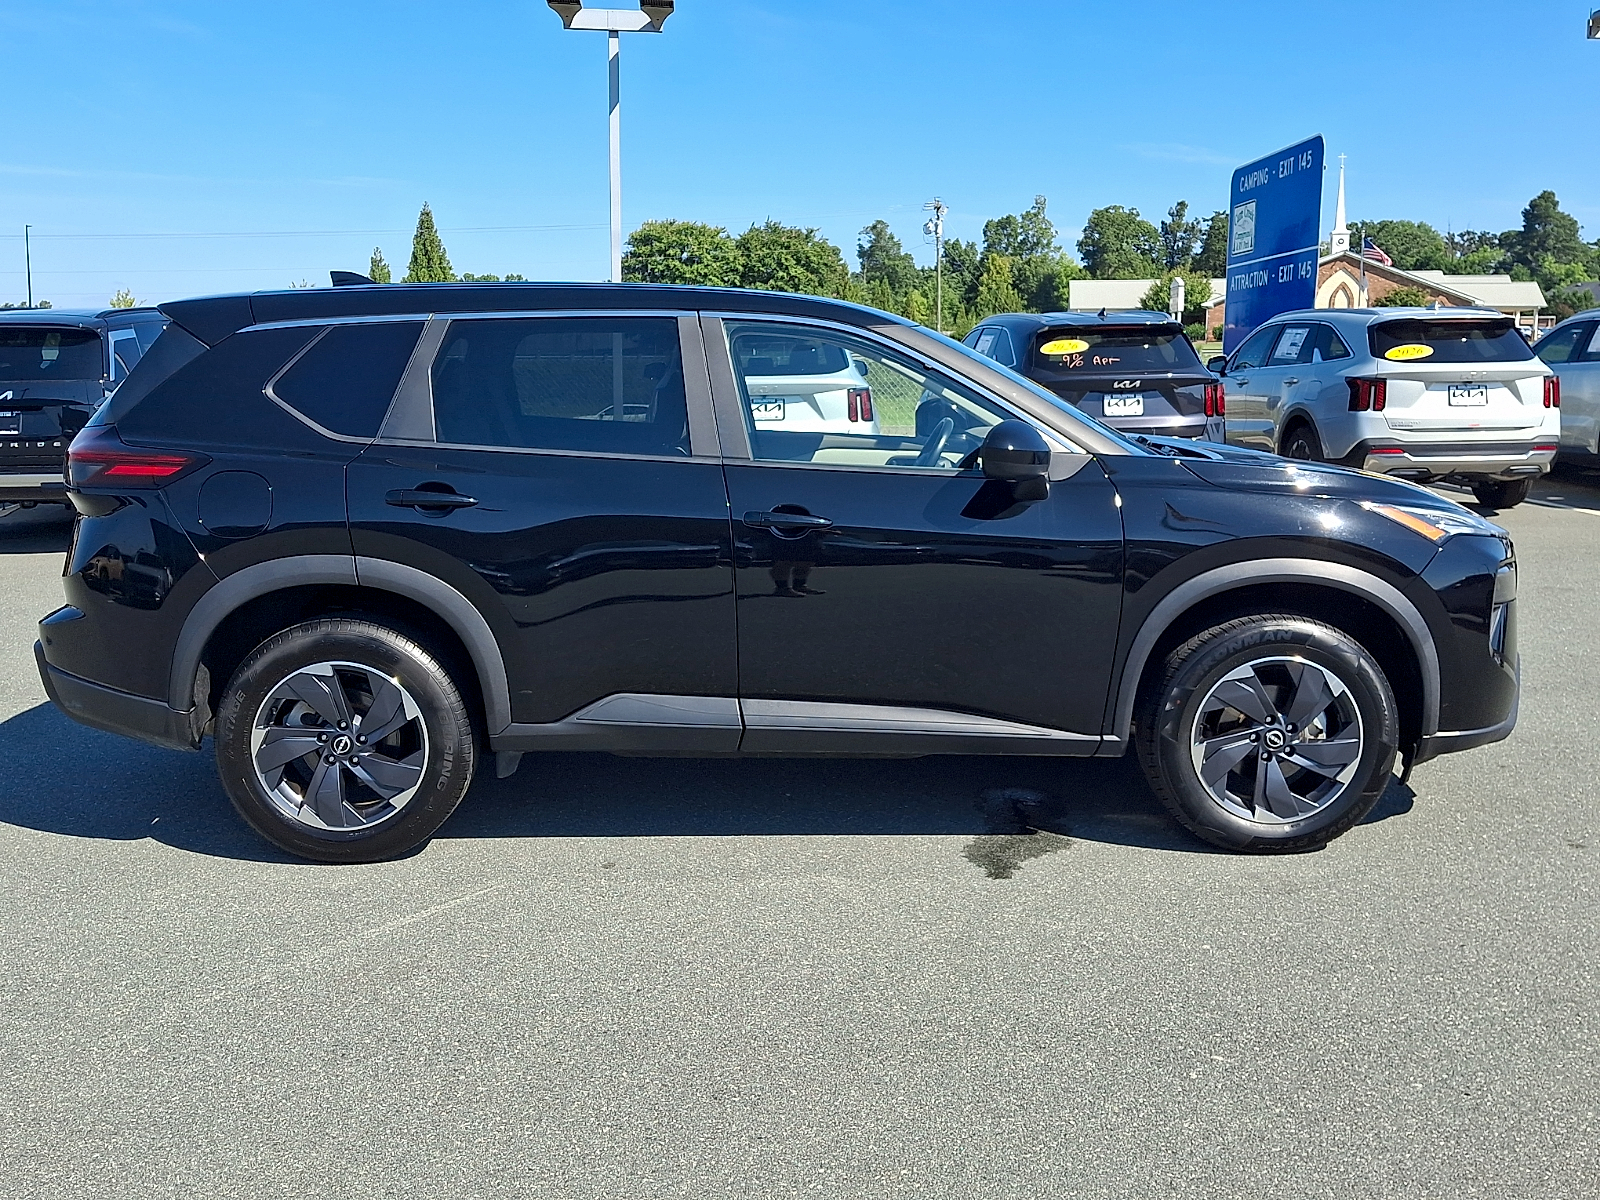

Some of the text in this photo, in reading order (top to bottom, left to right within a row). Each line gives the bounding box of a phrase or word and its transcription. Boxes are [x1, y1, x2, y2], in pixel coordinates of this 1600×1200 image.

[1239, 167, 1269, 193] CAMPING
[1278, 156, 1295, 179] EXIT
[1298, 149, 1313, 172] 145
[1230, 269, 1269, 292] ATTRACTION
[1278, 263, 1295, 283] EXIT
[1298, 260, 1312, 280] 145
[1107, 399, 1141, 407] KIA
[1453, 389, 1484, 398] KIA
